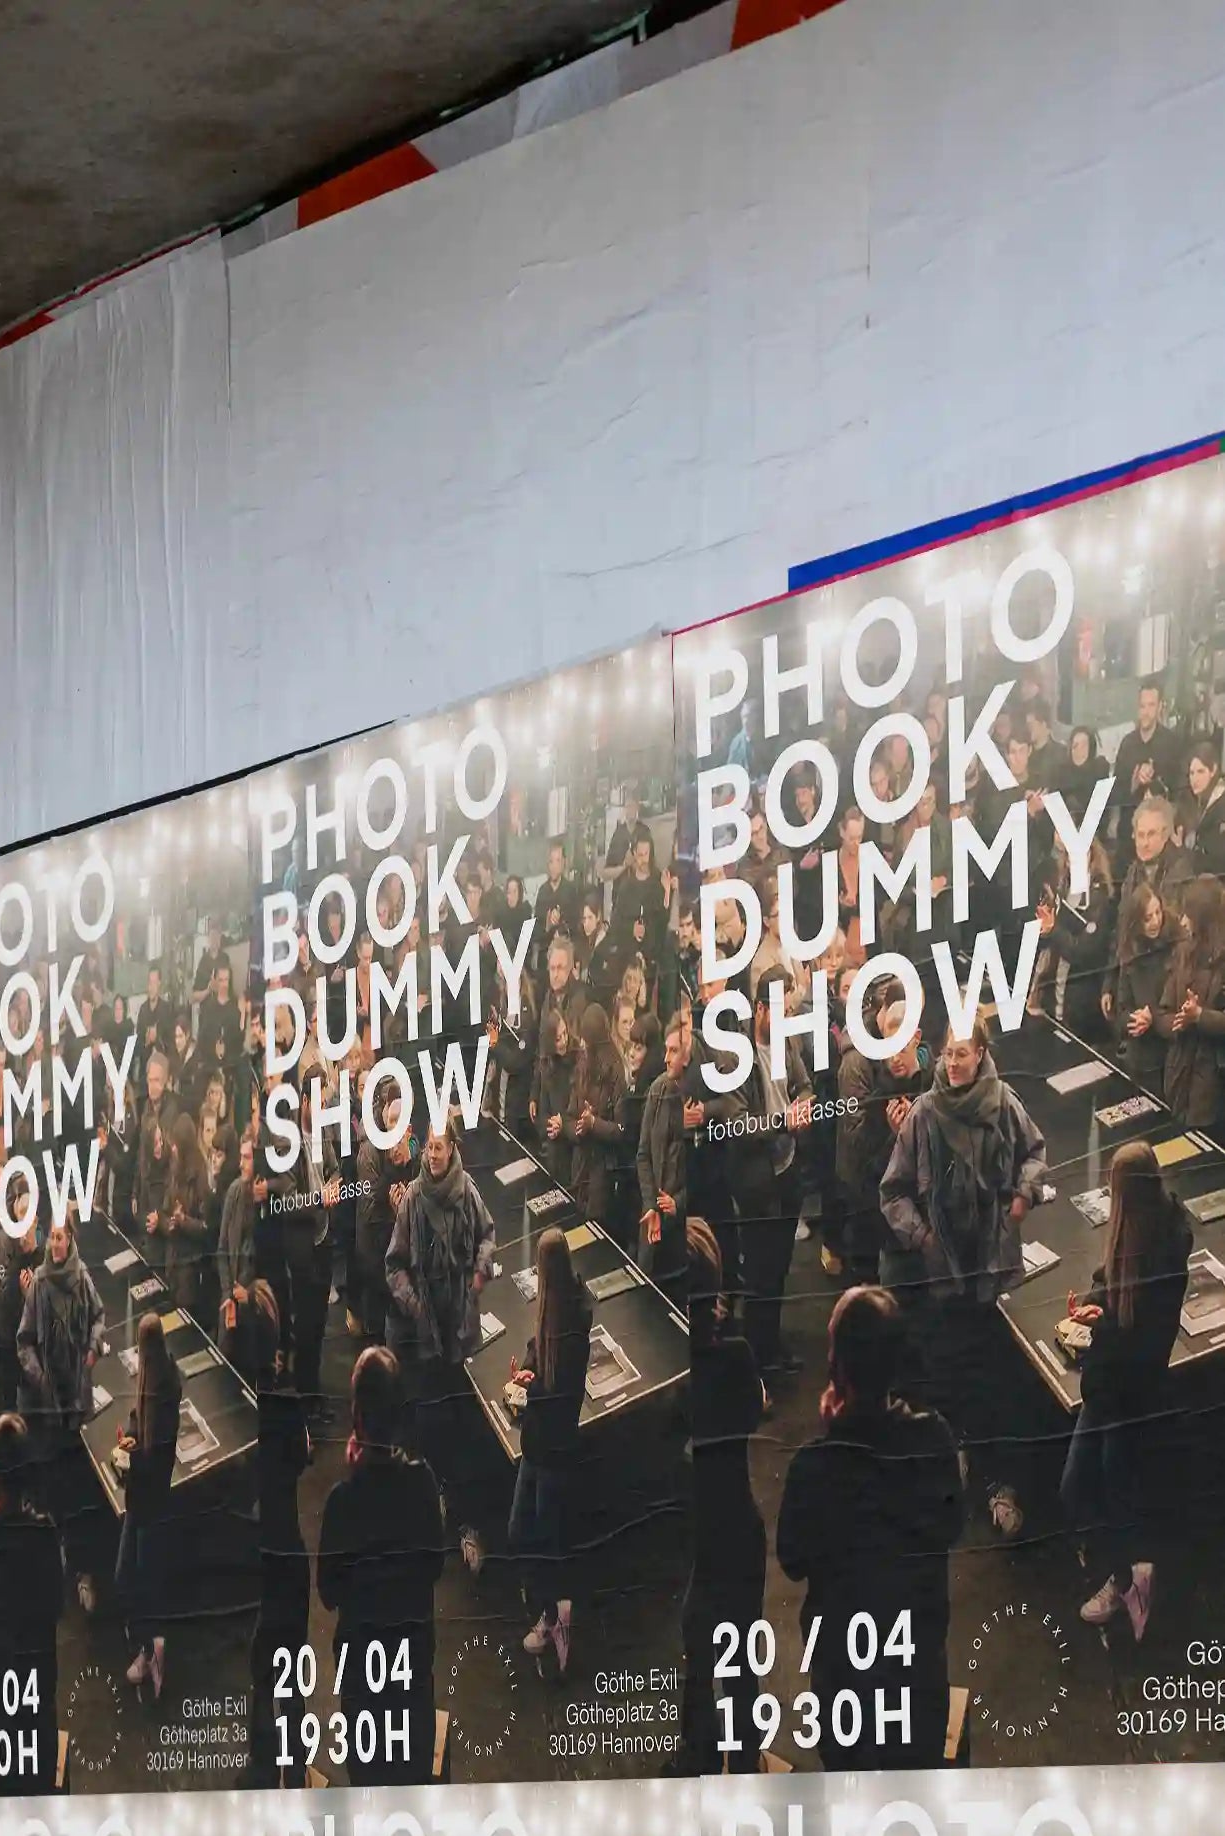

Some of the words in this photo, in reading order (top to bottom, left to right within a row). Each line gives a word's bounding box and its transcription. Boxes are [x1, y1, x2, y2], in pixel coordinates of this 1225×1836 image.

[694, 548, 1074, 760] PHOTO
[261, 726, 507, 885] PHOTO
[697, 679, 1019, 873] BOOK
[262, 832, 474, 981] BOOK
[699, 775, 1116, 984] DUMMY
[264, 917, 536, 1077] DUMMY
[699, 917, 1042, 1094] SHOW
[264, 1033, 490, 1173] SHOW
[706, 1094, 859, 1142] fotobuchklasse
[269, 1178, 371, 1215] fotobuchklasse
[272, 1646, 317, 1698] 20
[332, 1641, 349, 1695] /
[365, 1637, 412, 1693] 04
[712, 1621, 776, 1678] 20
[799, 1615, 823, 1673] /
[847, 1608, 915, 1671] 04
[2, 1667, 40, 1716] 04
[182, 1696, 221, 1718] Göthe
[224, 1694, 247, 1715] Exil
[594, 1668, 644, 1693] Göthe
[649, 1665, 678, 1690] Exil
[159, 1722, 228, 1748] Götheplatz
[231, 1722, 247, 1741] 3a
[274, 1708, 410, 1767] 1930H
[565, 1699, 654, 1729] Götheplatz
[657, 1699, 679, 1721] 3a
[715, 1685, 912, 1752] 1930H
[1115, 1708, 1188, 1735] 30169
[146, 1751, 184, 1771] 30169
[187, 1750, 248, 1770] Hannover
[548, 1732, 597, 1757] 30169
[601, 1732, 680, 1755] Hannover
